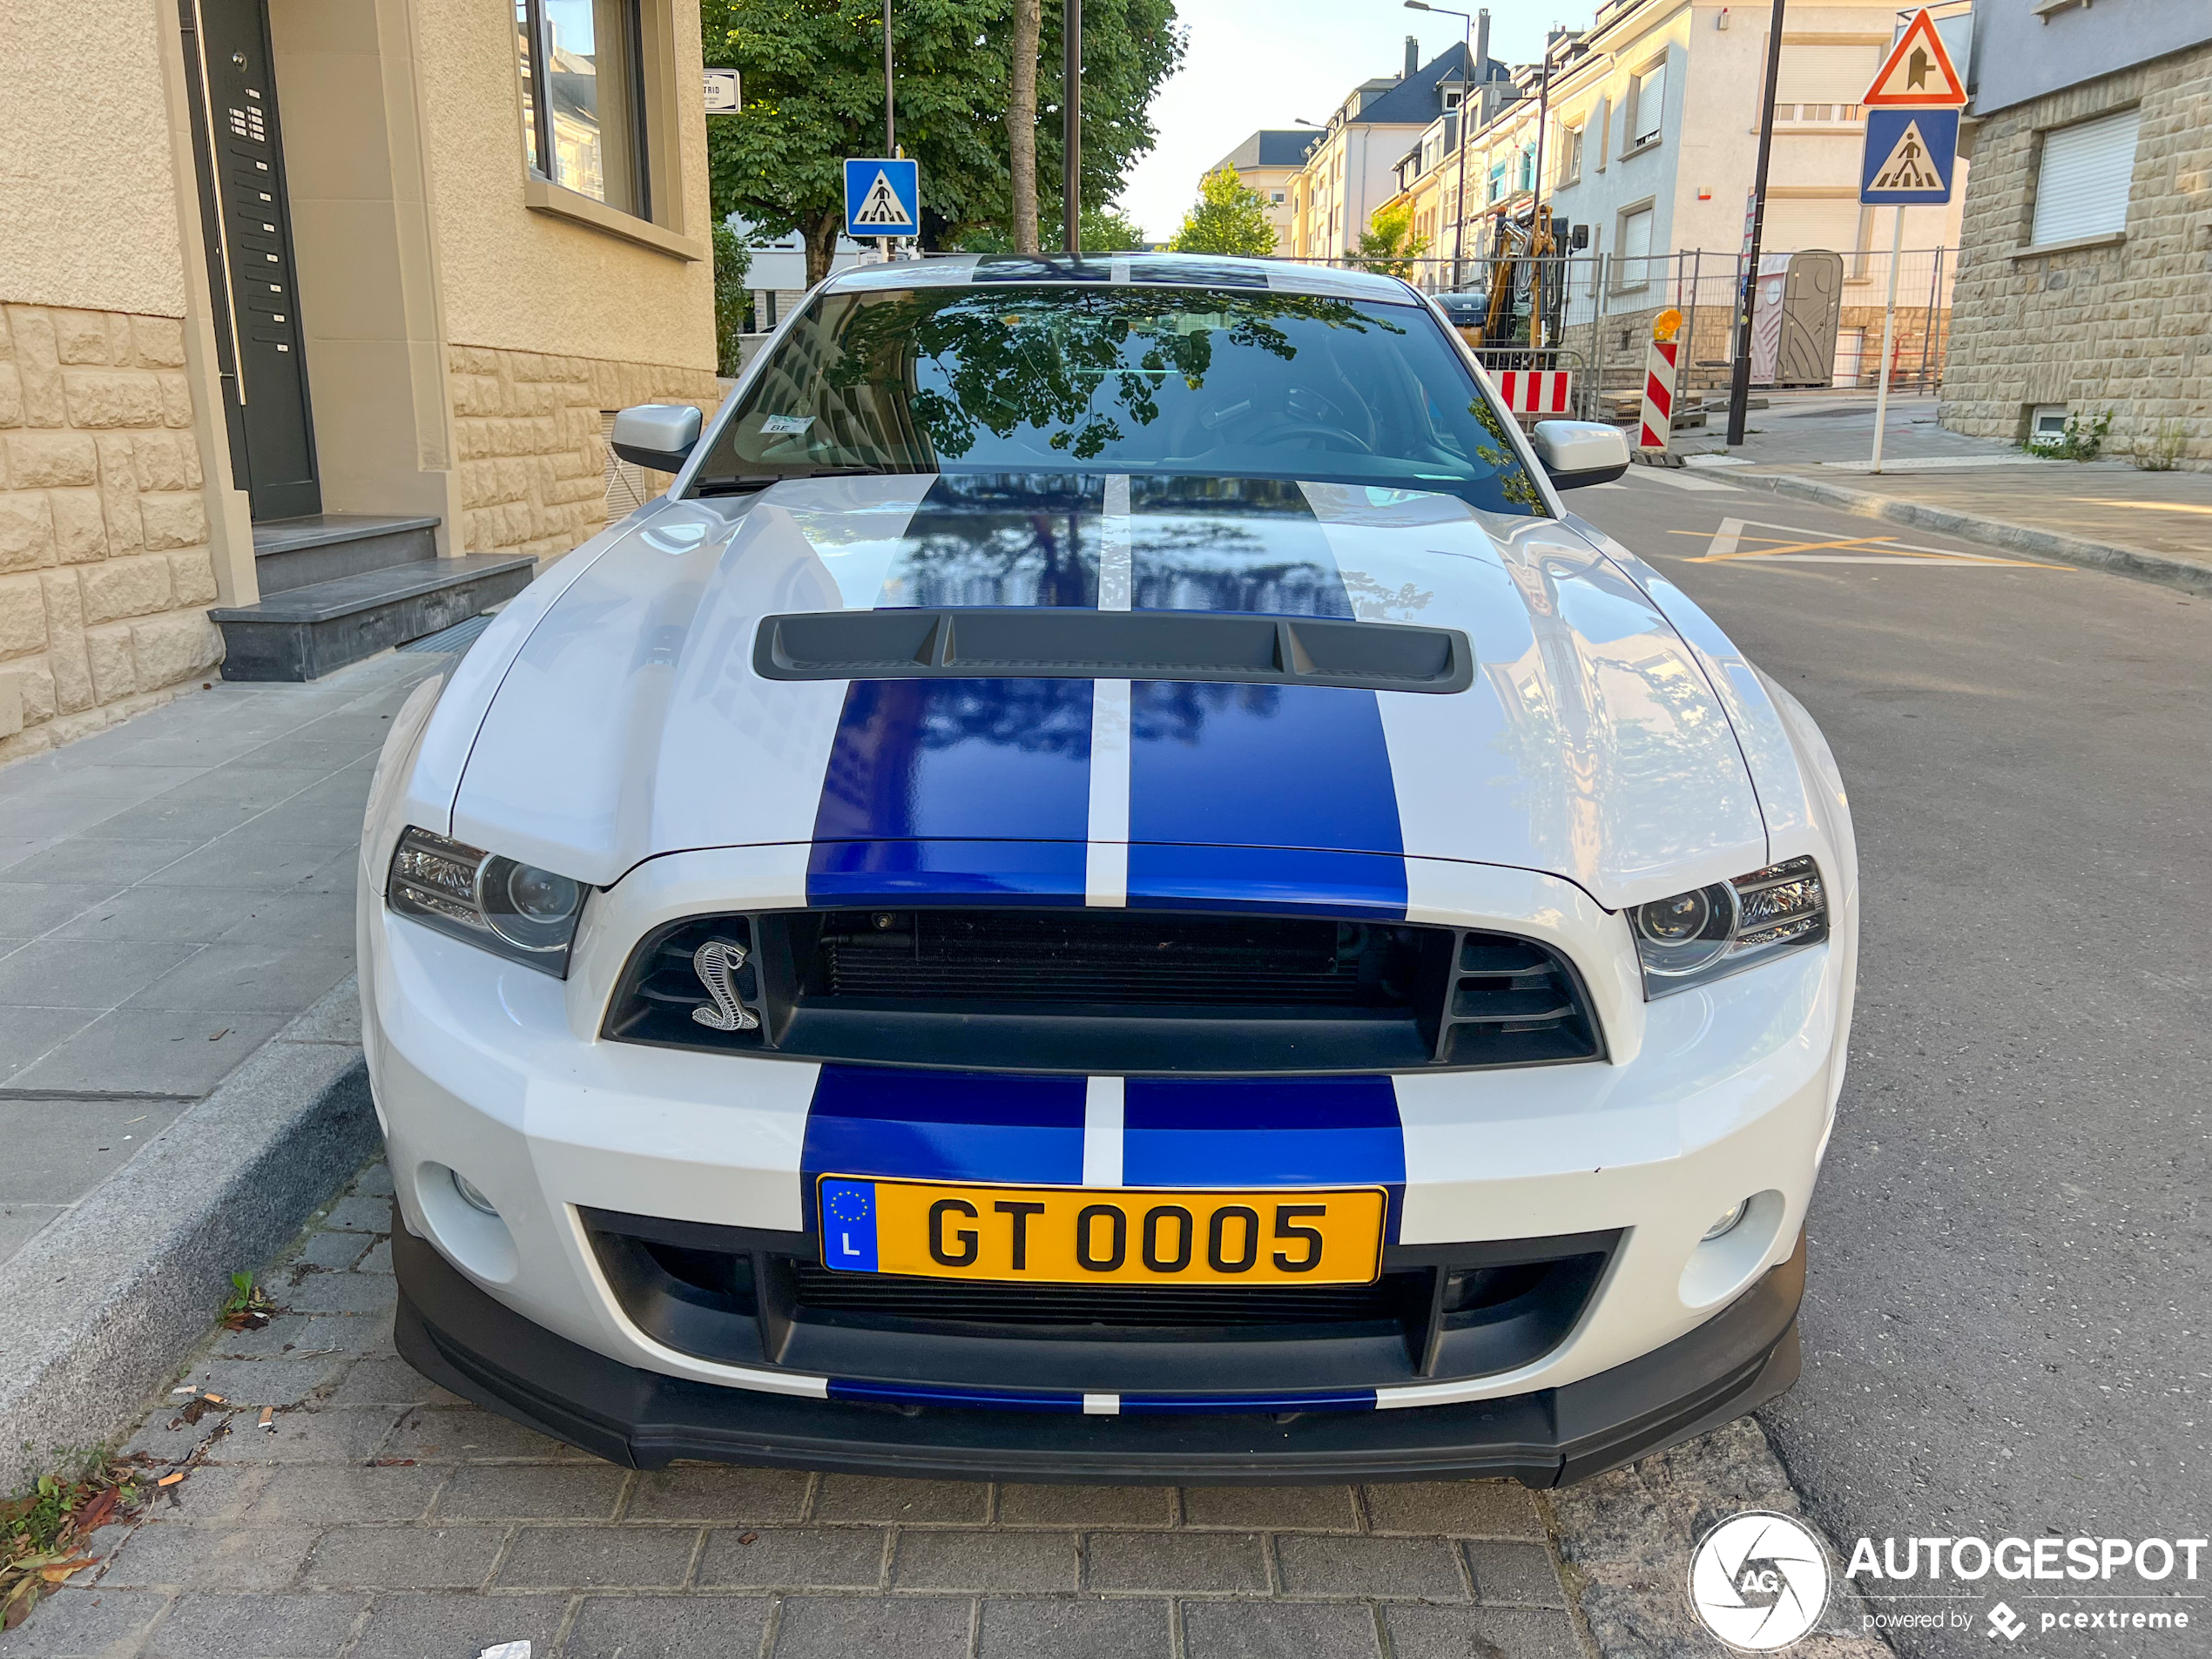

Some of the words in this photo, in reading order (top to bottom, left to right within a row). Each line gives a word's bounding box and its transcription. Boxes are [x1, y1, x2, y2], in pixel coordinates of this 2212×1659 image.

[841, 1232, 860, 1257] L
[928, 1198, 1045, 1271] GT
[1076, 1204, 1327, 1274] 0005
